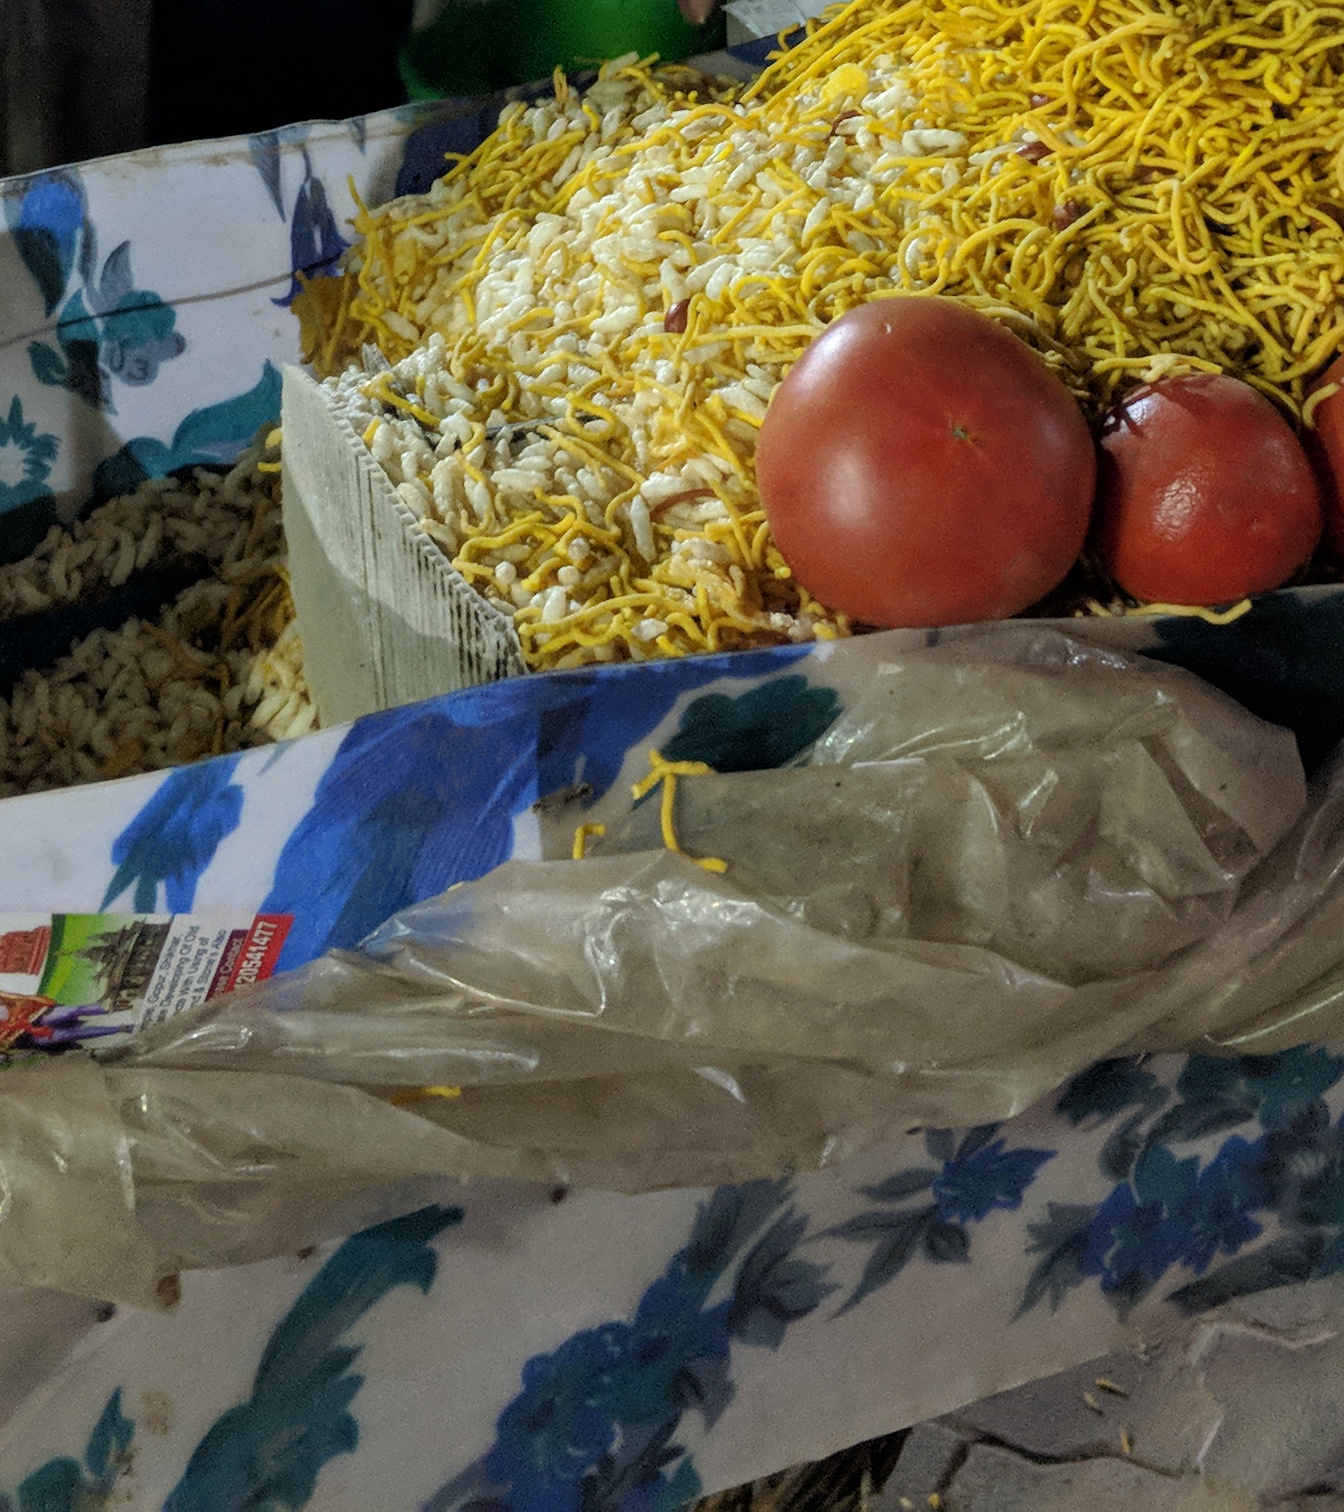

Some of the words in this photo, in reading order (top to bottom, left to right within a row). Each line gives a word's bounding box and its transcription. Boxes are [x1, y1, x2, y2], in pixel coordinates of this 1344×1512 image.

[210, 928, 227, 949] Also
[159, 956, 191, 1008] Developing
[184, 925, 200, 943] Old
[187, 947, 208, 975] Using
[219, 937, 244, 975] Contact
